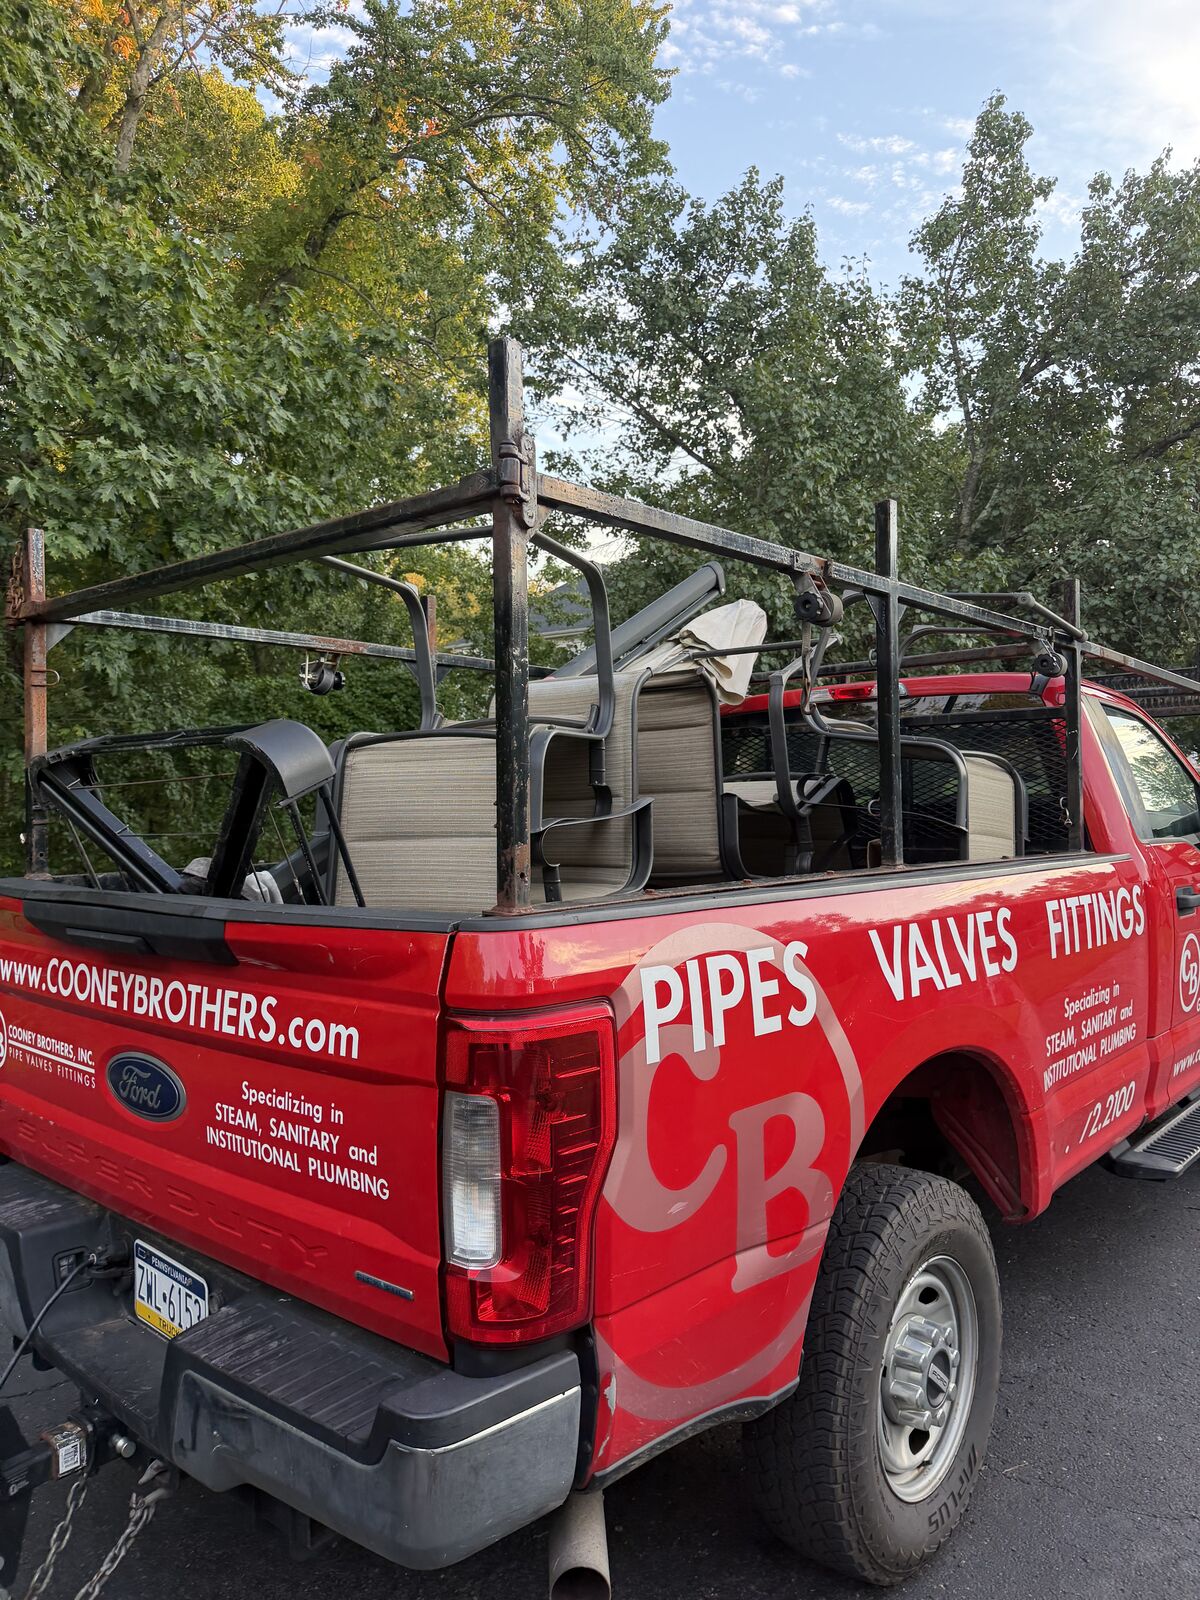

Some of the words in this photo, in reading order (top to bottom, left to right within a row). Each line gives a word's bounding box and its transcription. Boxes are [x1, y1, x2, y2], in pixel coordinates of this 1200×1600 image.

[639, 940, 818, 1065] PIPES
[868, 907, 1018, 1001] VALVES
[1045, 884, 1145, 960] FITTINGS
[1064, 985, 1110, 1021] Specializing
[1113, 979, 1120, 997] in
[8, 1024, 36, 1046] COONEY
[36, 1033, 76, 1062] BROTHERS,
[78, 1047, 95, 1066] INC.
[1046, 1025, 1077, 1057] STEAM,
[1081, 1006, 1118, 1040] SANITARY
[1120, 998, 1133, 1020] and
[8, 1046, 23, 1062] PIPE
[26, 1053, 52, 1073] VALVES
[57, 1064, 96, 1089] FITTINGS
[1043, 1043, 1097, 1093] INSTITUTIONAL
[1100, 1022, 1136, 1057] PLUMBING
[118, 1065, 162, 1109] Ford
[241, 1080, 323, 1124] Specializing
[330, 1102, 344, 1125] in
[215, 1102, 262, 1137] STEAM,
[269, 1117, 340, 1155] SANITARY
[348, 1145, 377, 1166] and
[206, 1125, 301, 1174] INSTITUTIONAL
[308, 1157, 390, 1201] PLUMBING
[151, 1256, 189, 1286] PENNSYLVANIA
